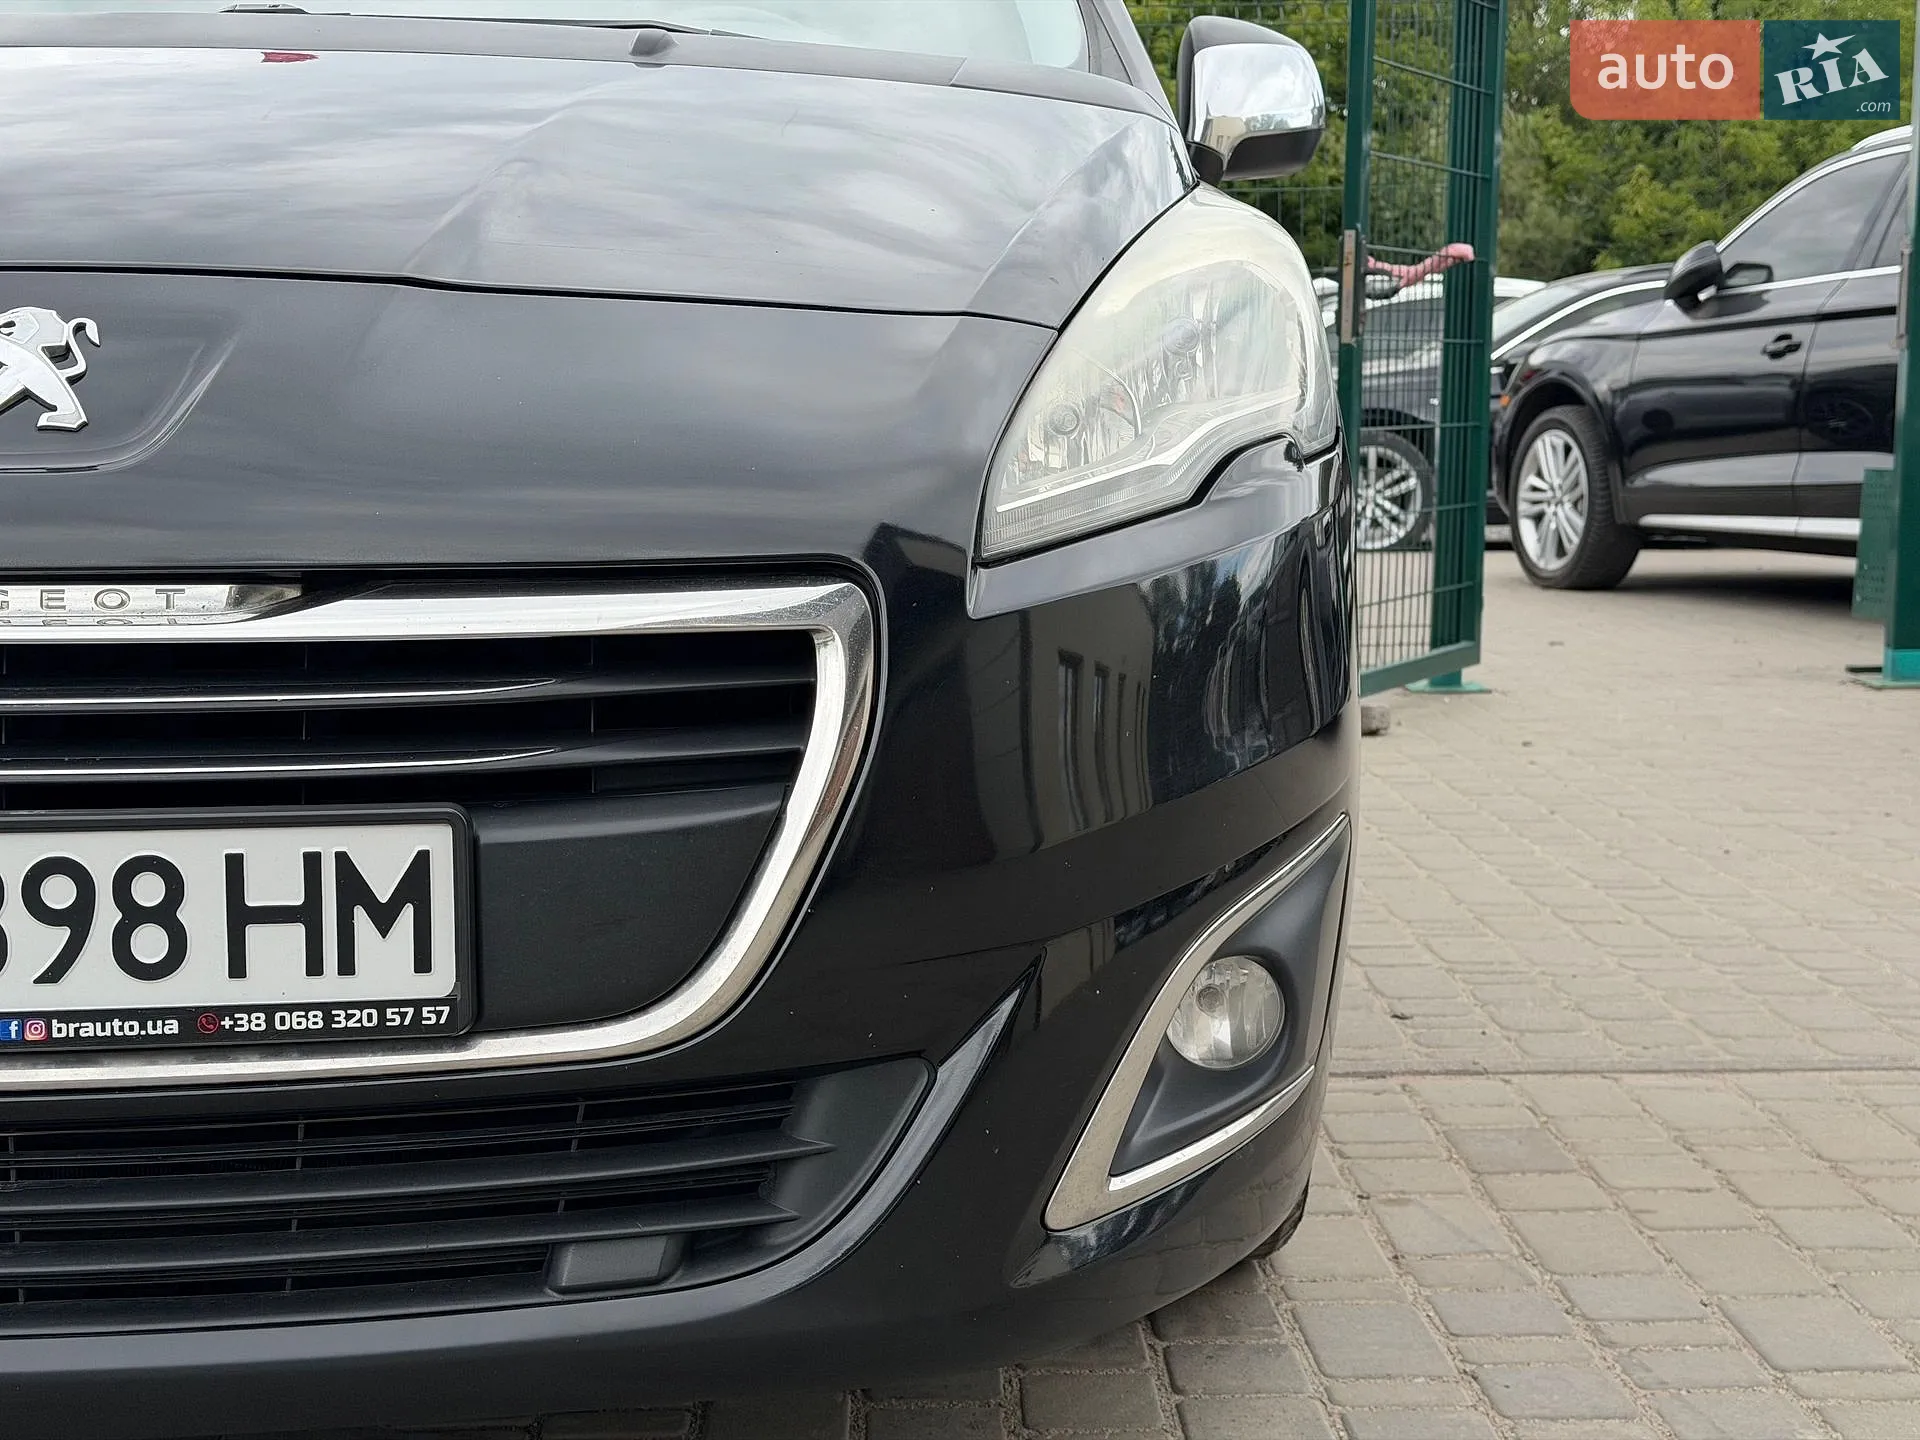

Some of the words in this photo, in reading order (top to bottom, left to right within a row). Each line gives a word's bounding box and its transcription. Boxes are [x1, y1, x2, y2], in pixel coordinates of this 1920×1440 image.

[0, 588, 186, 611] EOT
[0, 854, 188, 985] 98
[224, 848, 433, 979] HM
[51, 1018, 179, 1039] brauto.ua
[220, 1011, 267, 1033] +38
[274, 1010, 324, 1031] 068
[331, 1008, 378, 1029] 320
[385, 1006, 415, 1027] 57
[421, 1005, 451, 1026] 57
